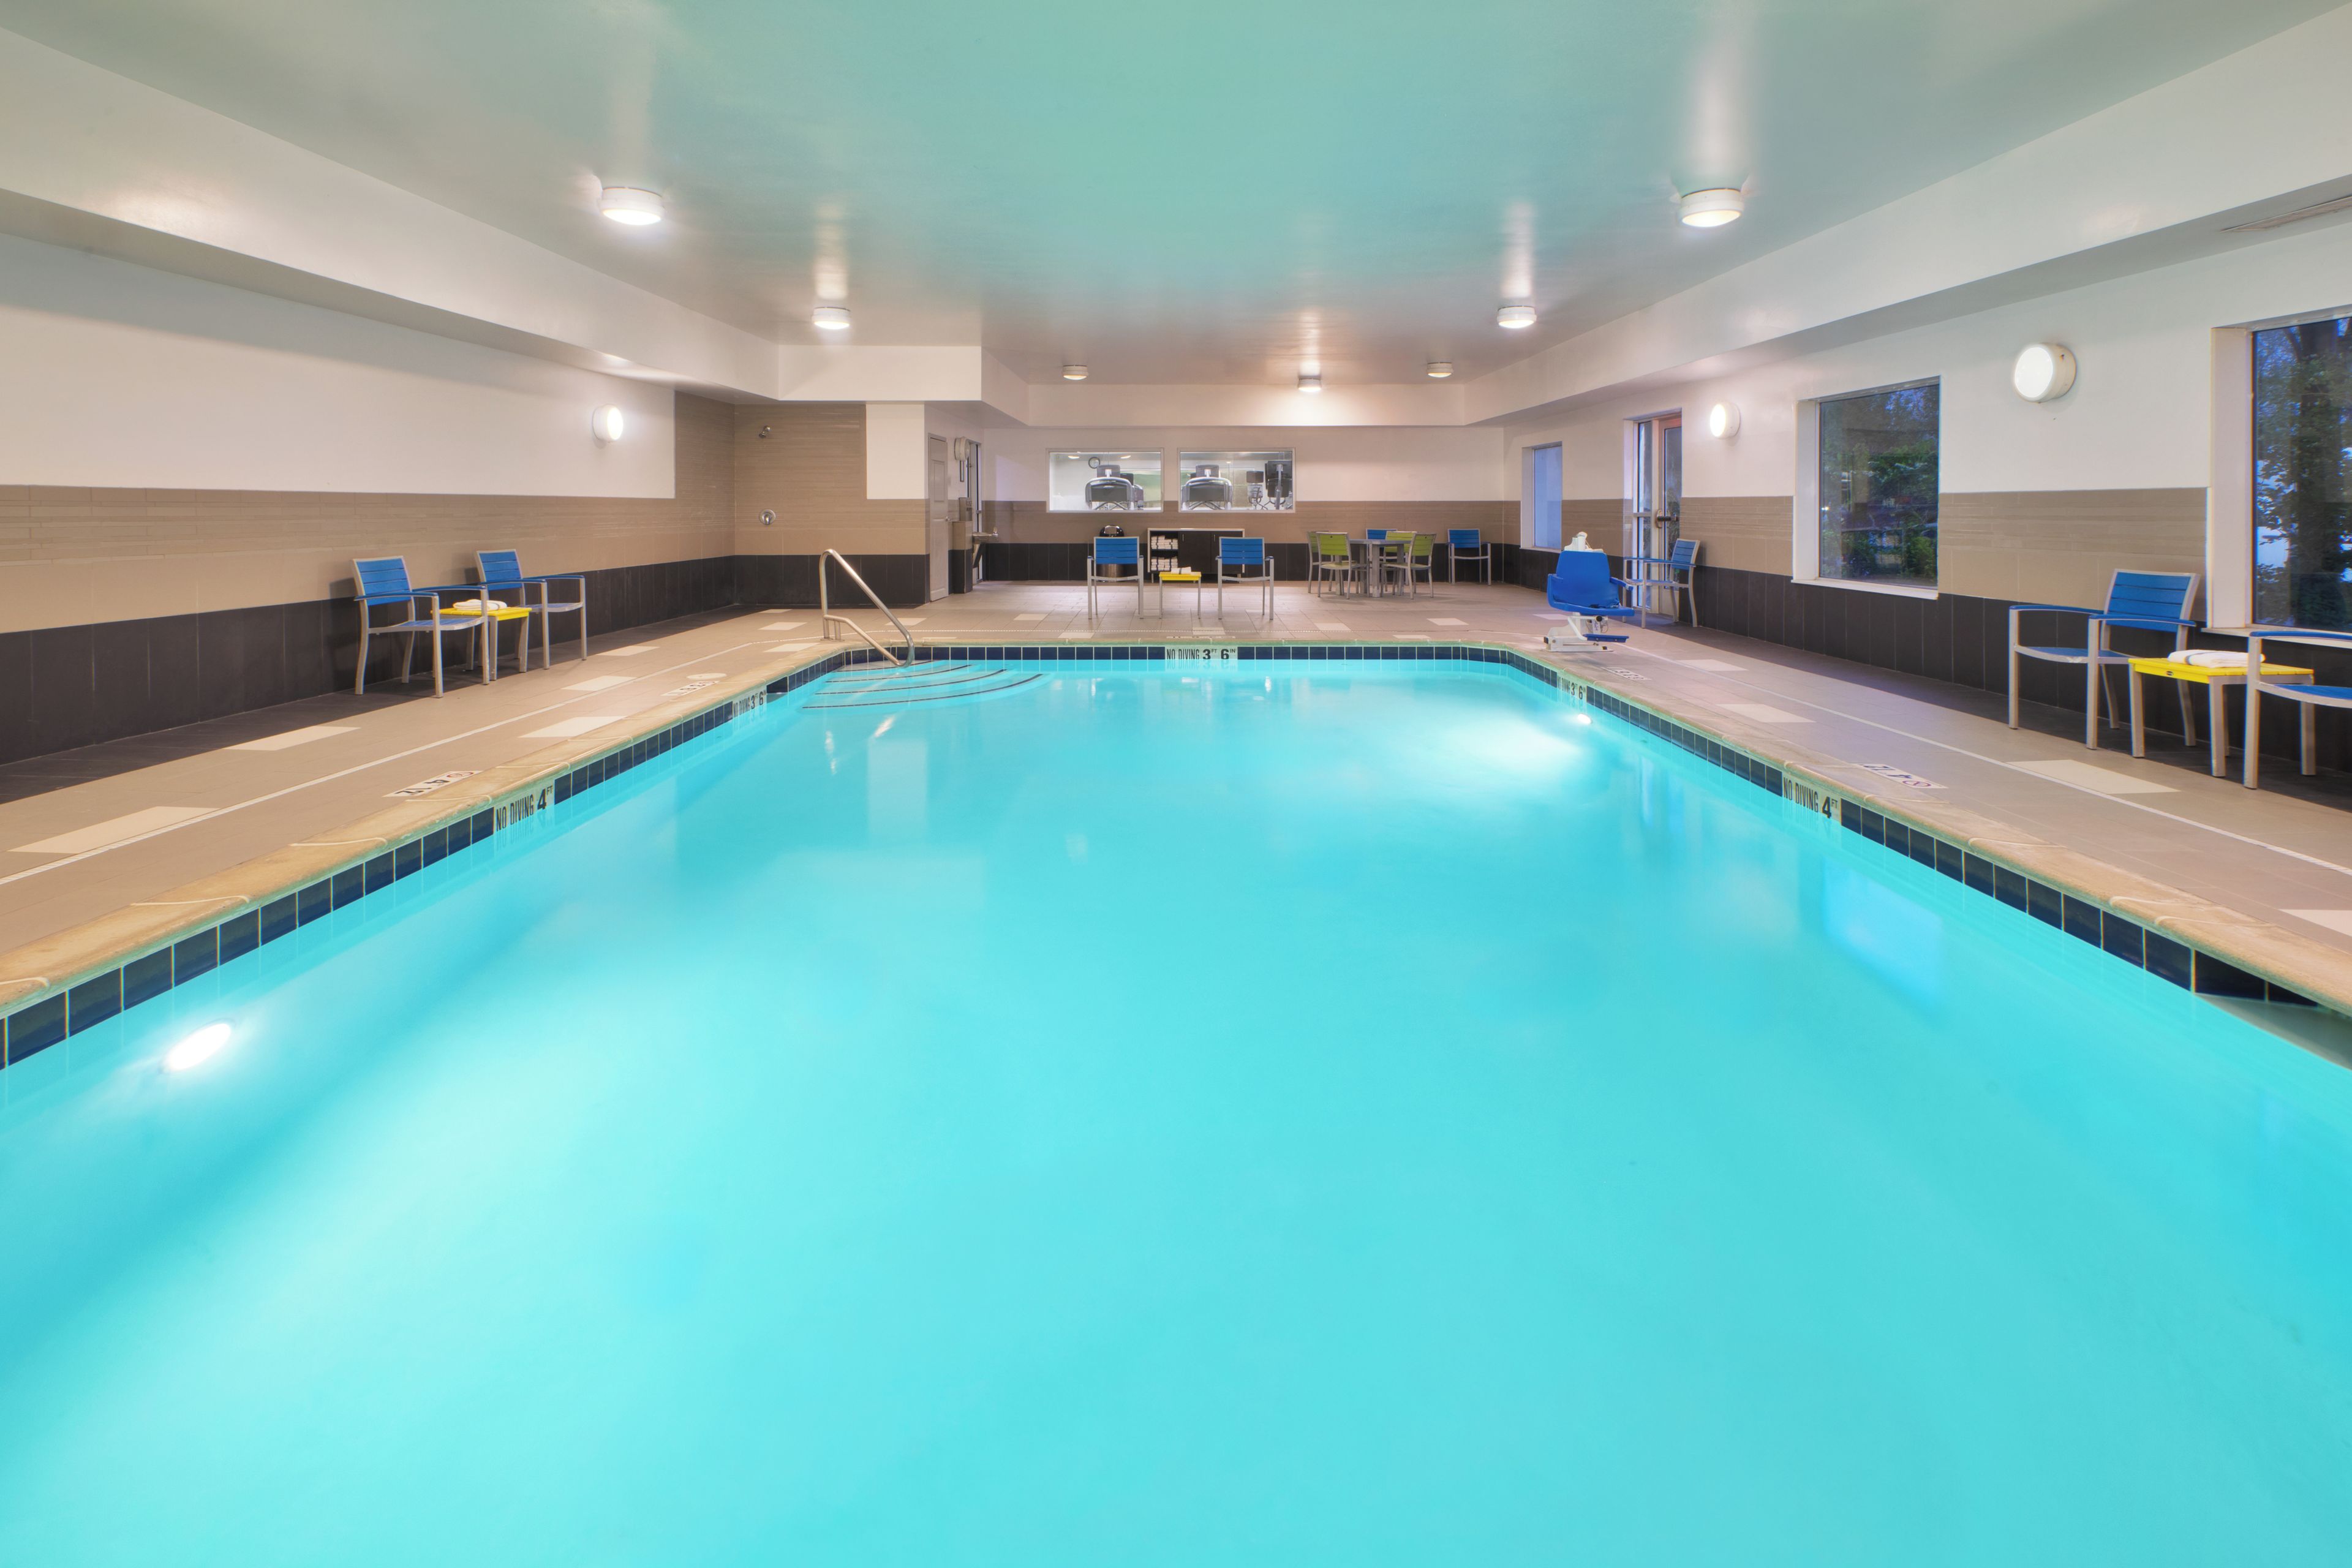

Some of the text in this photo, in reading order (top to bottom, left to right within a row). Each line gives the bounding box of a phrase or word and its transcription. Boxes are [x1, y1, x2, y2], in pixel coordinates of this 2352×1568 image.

[1166, 649, 1175, 660] NO
[1178, 649, 1200, 660] DIVING
[1202, 649, 1211, 660] 3
[1221, 649, 1229, 660] 6
[496, 806, 507, 832] NO
[510, 794, 534, 825] DIVING
[1783, 777, 1793, 801] NO
[1795, 782, 1819, 813] DIVING
